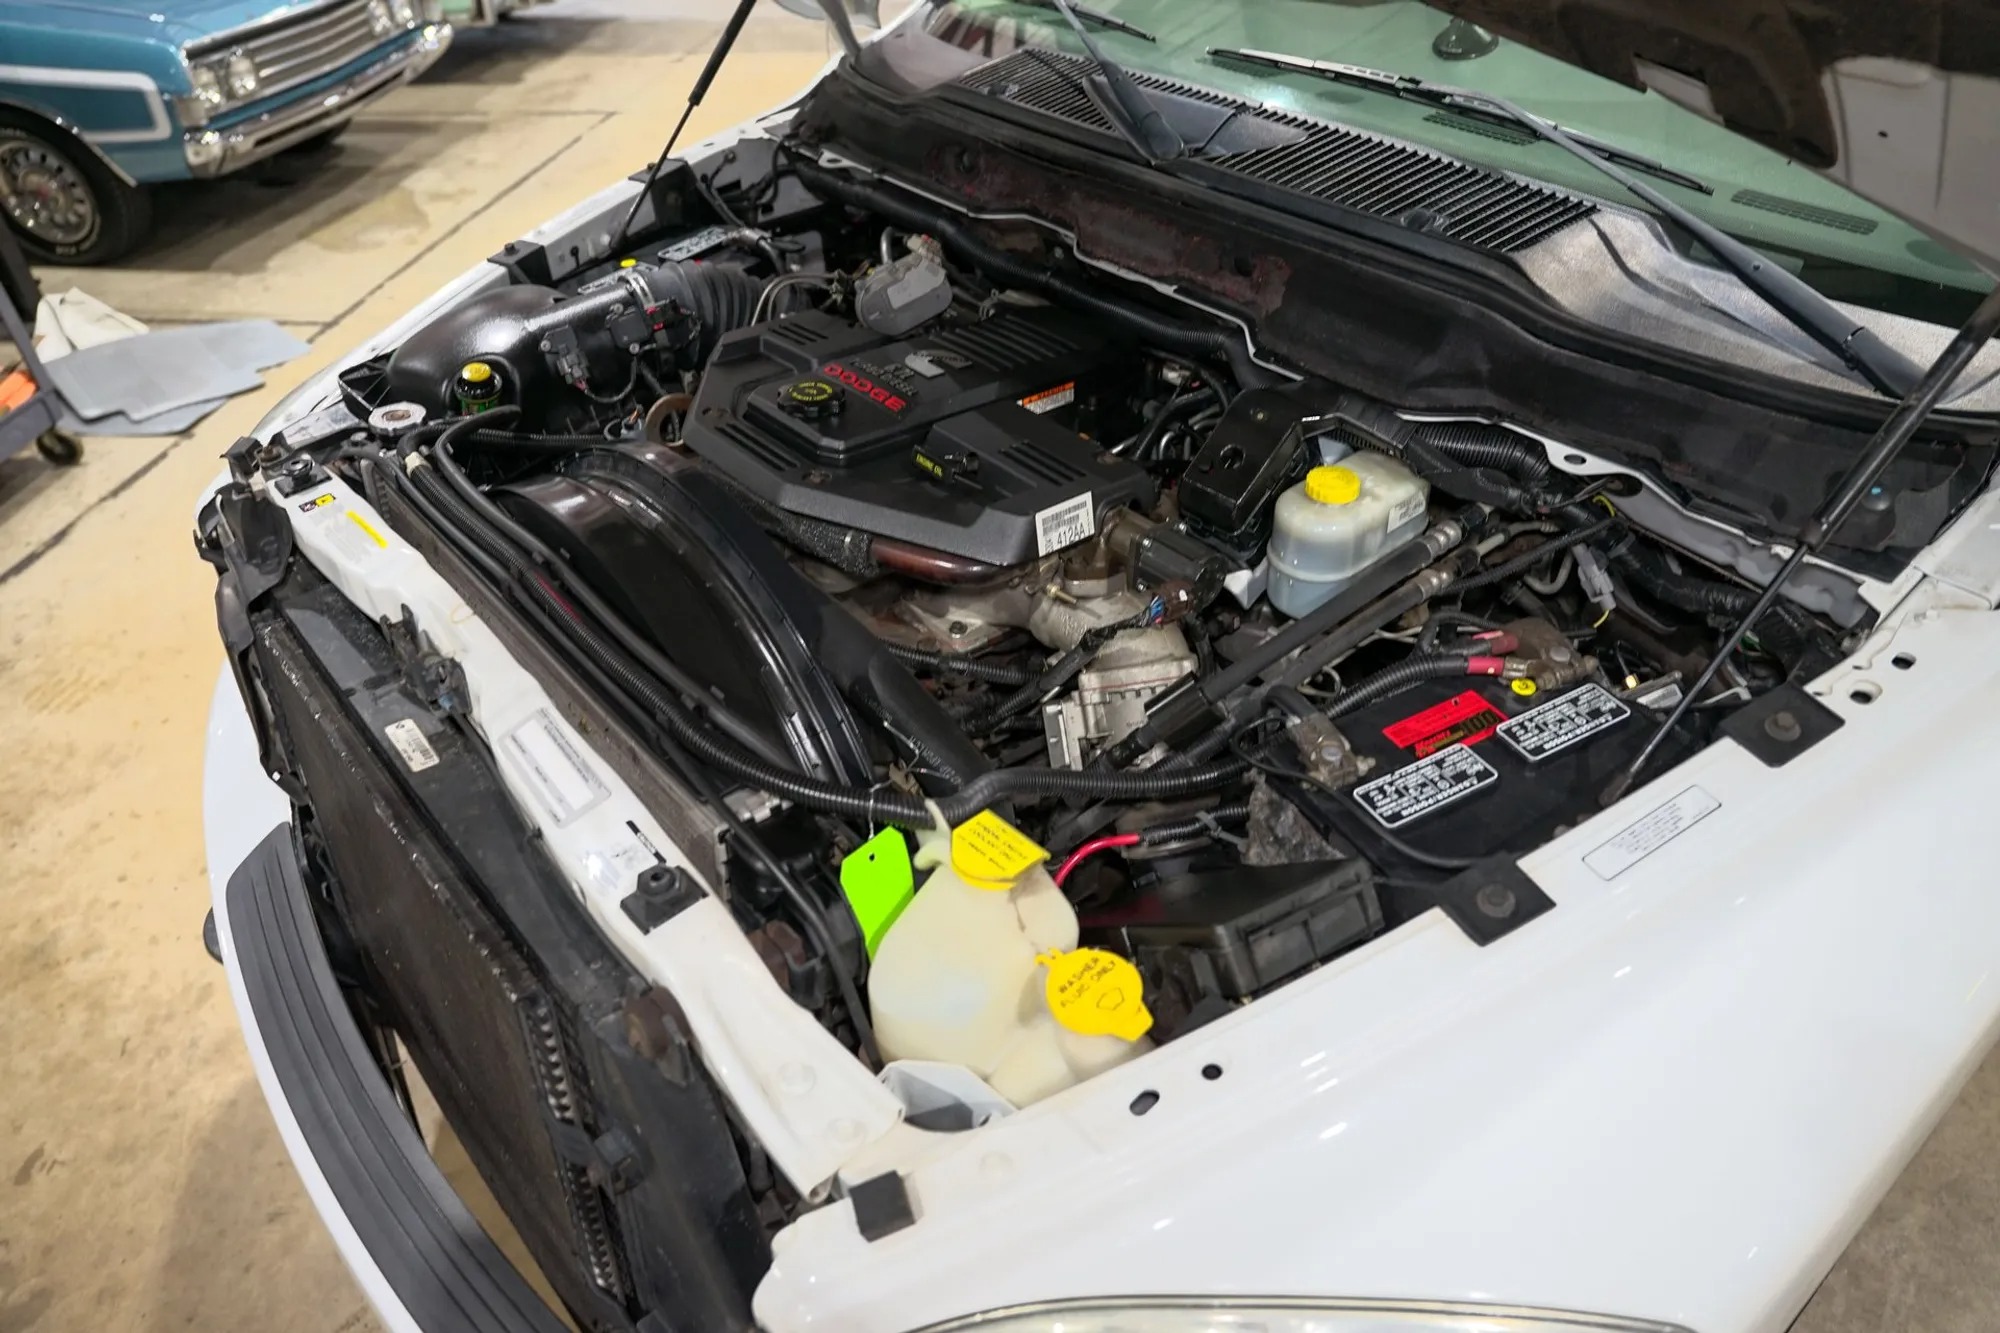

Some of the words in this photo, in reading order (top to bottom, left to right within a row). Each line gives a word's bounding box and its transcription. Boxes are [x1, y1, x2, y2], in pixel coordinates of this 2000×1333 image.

[824, 362, 906, 412] DODGE
[1057, 523, 1087, 547] 412AA
[1058, 957, 1100, 994] WASHER
